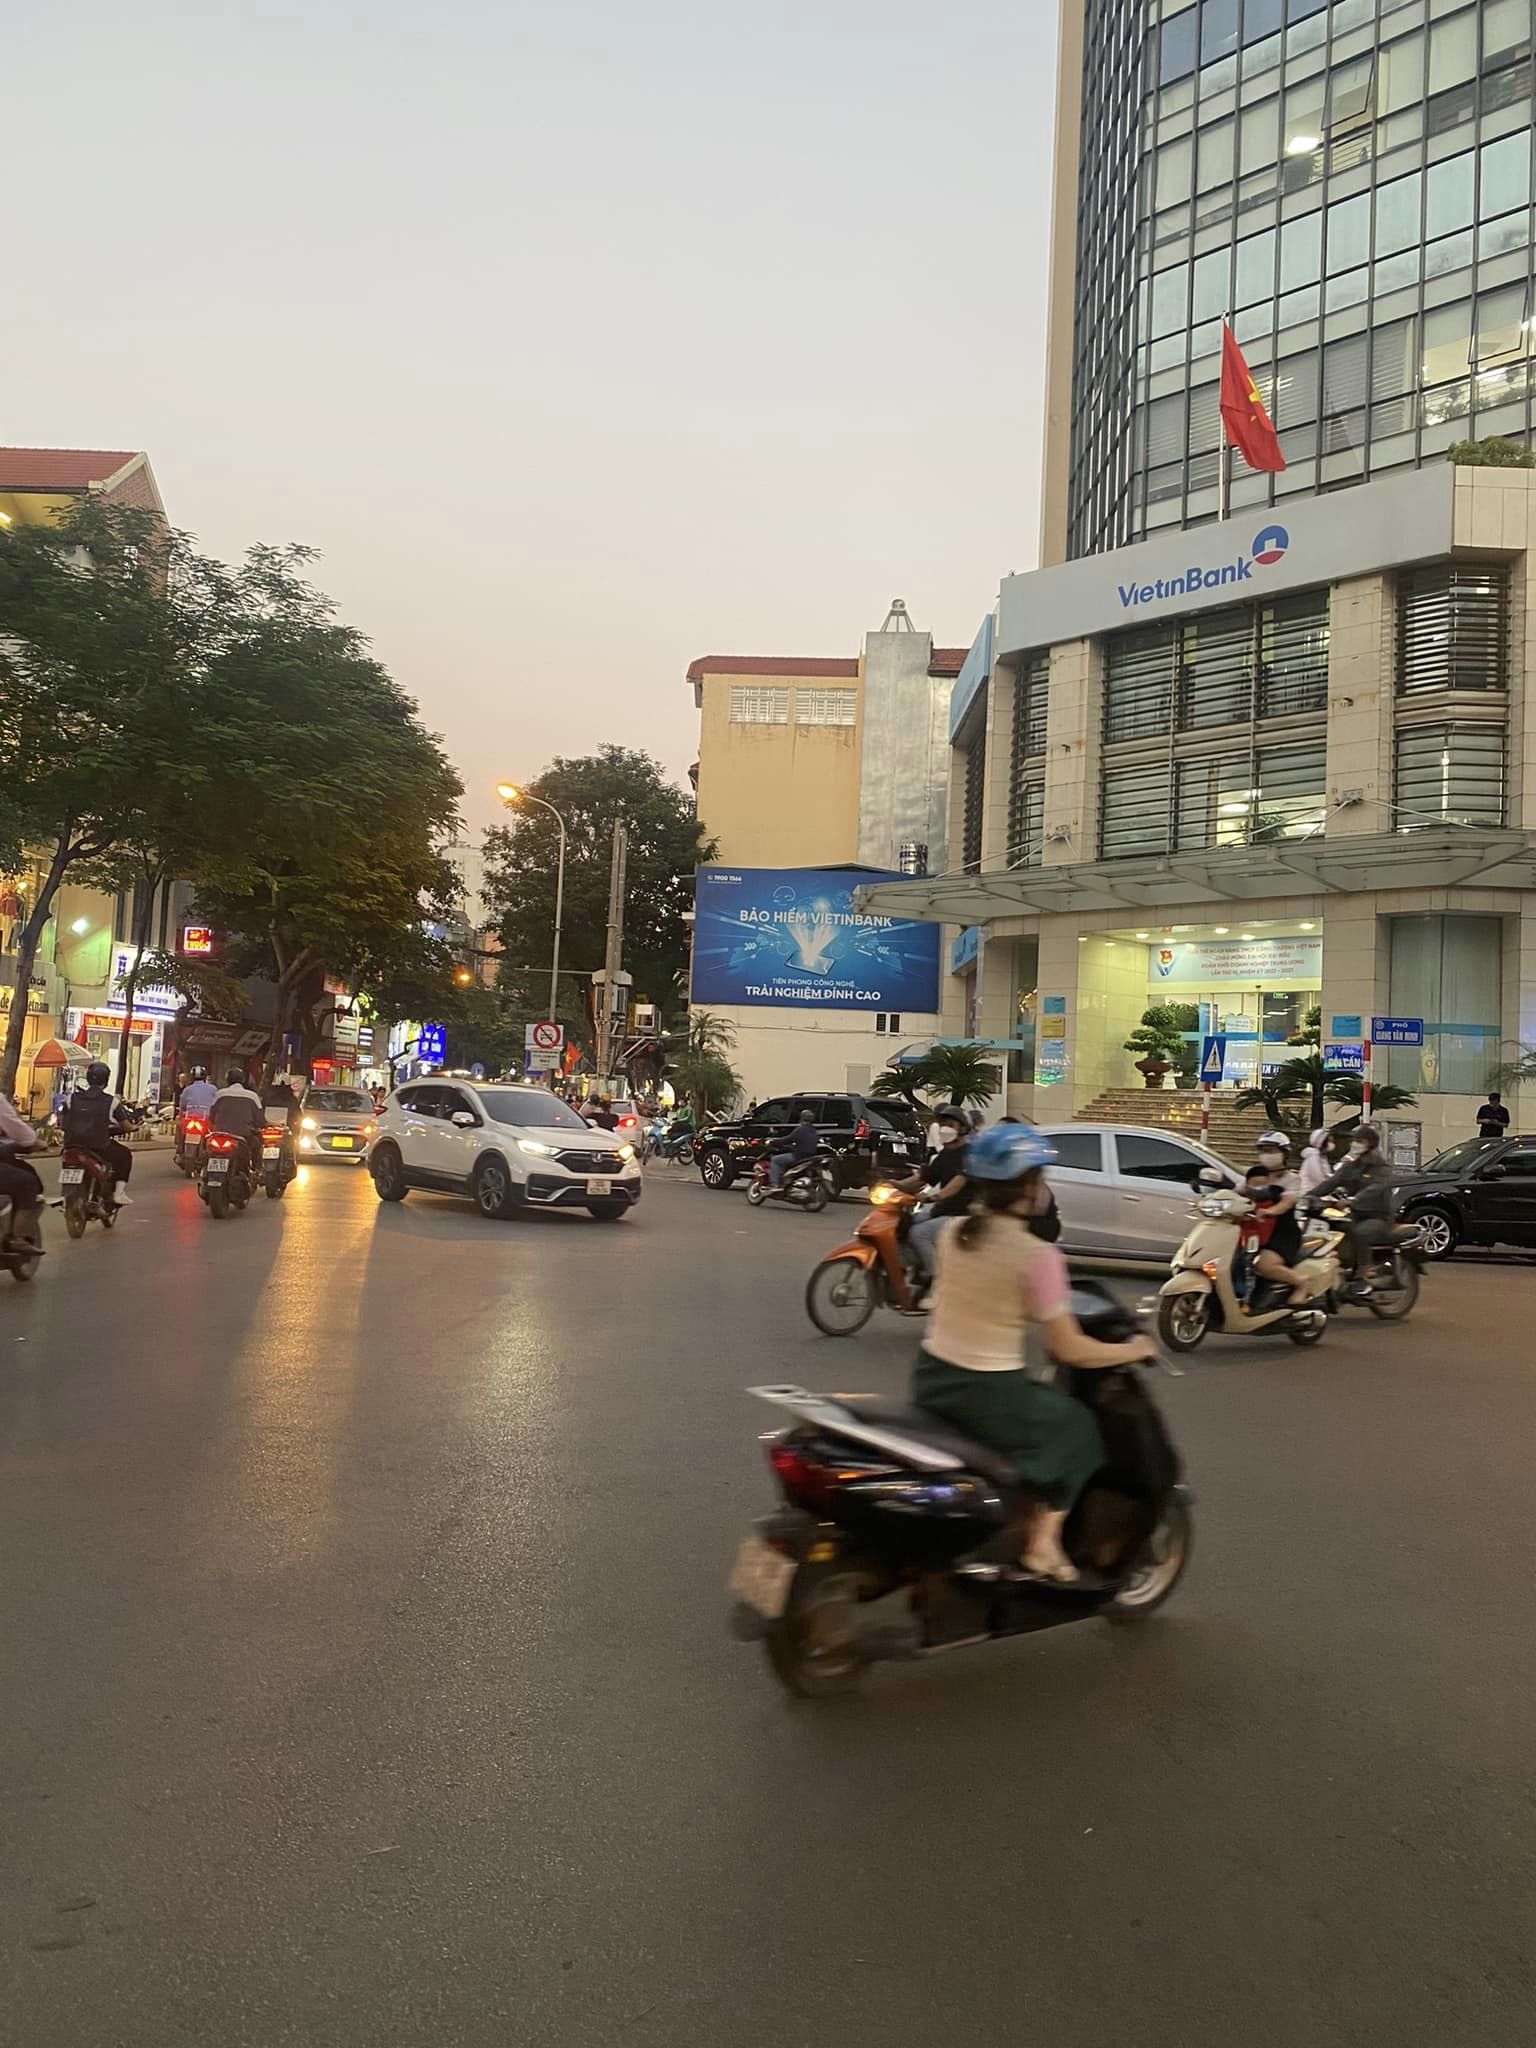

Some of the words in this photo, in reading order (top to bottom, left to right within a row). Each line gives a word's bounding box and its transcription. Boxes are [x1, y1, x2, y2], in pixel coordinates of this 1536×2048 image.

[1118, 557, 1254, 607] VietinBank
[739, 907, 770, 922] BẢO
[774, 907, 807, 924] HIỂM
[811, 913, 892, 927] VIETINBANK
[788, 978, 812, 986] PHONG
[813, 978, 835, 987] CÔNG
[745, 984, 772, 997] TRẢI
[774, 985, 822, 1000] NGHIỆM
[824, 986, 854, 1000] ĐỈNH
[855, 990, 881, 1001] CAO
